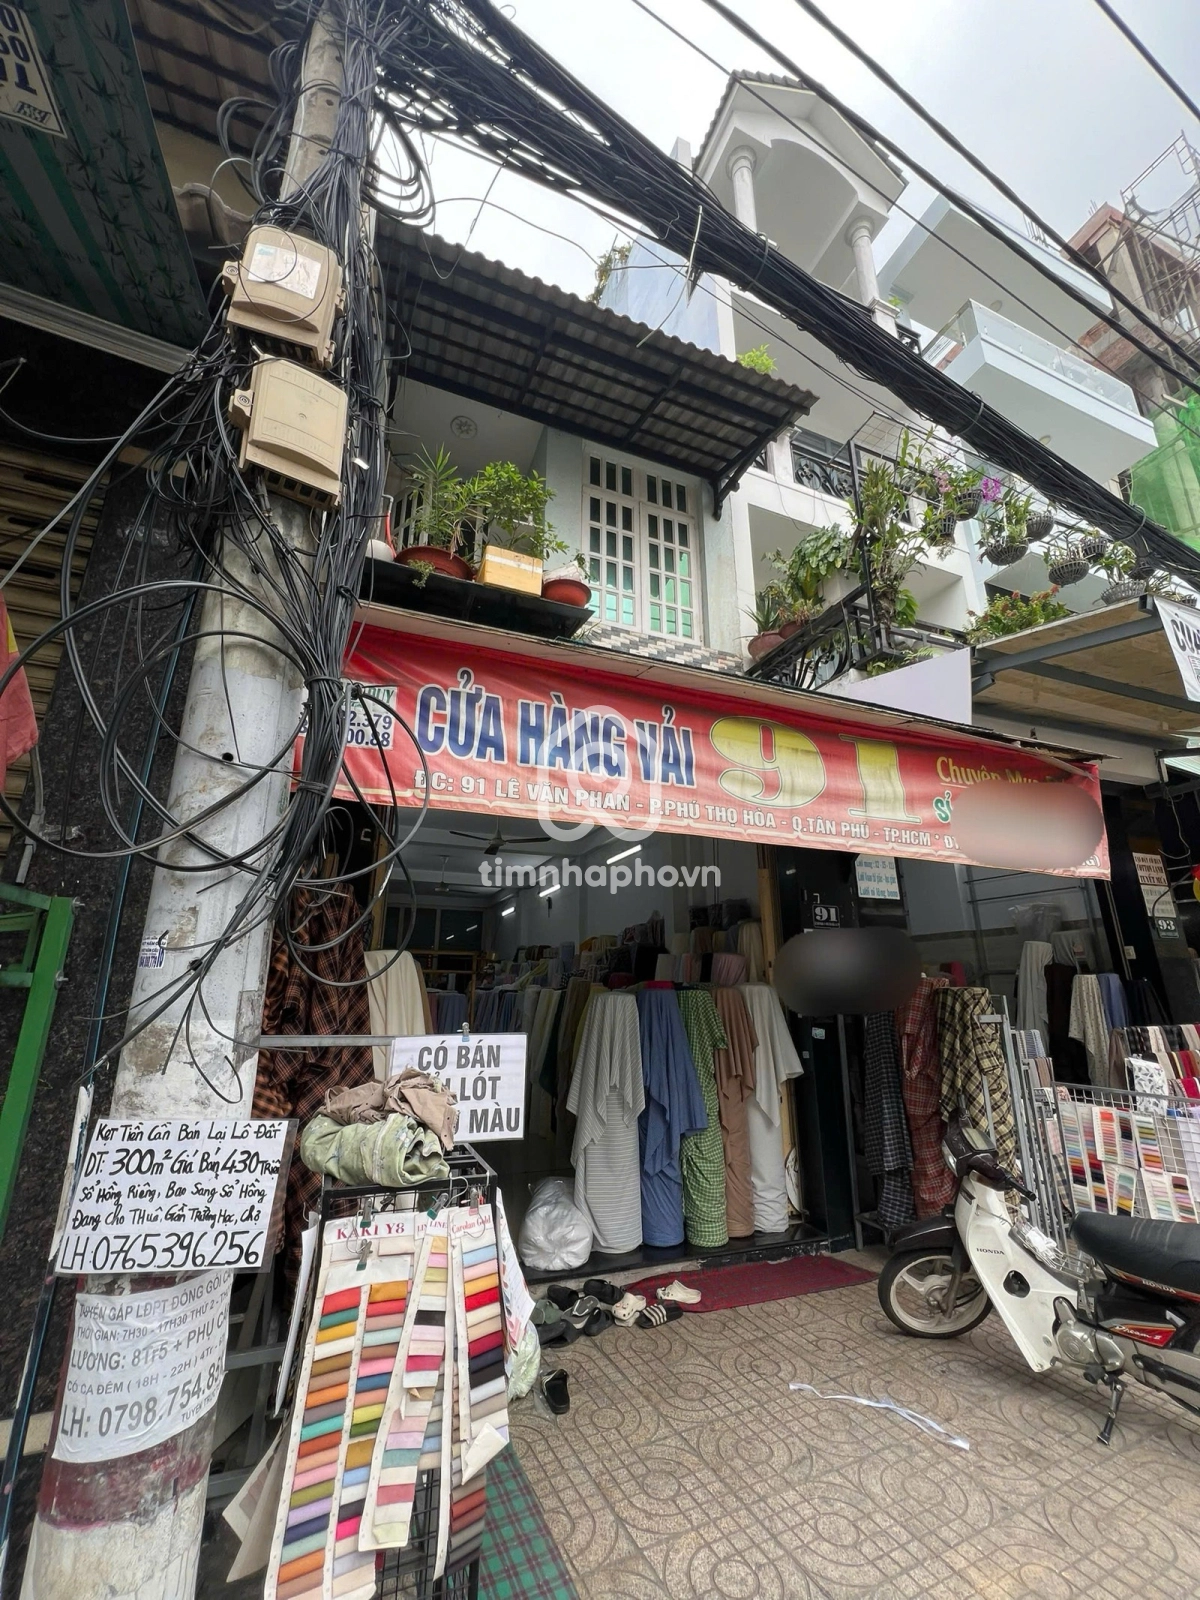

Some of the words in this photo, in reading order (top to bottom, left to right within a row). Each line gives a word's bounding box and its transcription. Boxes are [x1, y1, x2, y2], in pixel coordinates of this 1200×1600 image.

[415, 667, 507, 764] CỬA
[517, 692, 629, 779] HÀNG
[633, 705, 697, 788] VẢI
[709, 715, 922, 825] 91
[414, 769, 455, 792] ĐC:
[461, 776, 486, 795] 91
[495, 778, 520, 799] LÊ
[527, 780, 569, 806] VĂN
[575, 789, 631, 813] PHAN
[649, 798, 701, 820] P.PHÚ
[705, 804, 737, 827] THỌ
[742, 802, 777, 829] HÒA
[792, 815, 837, 837] Q.TÂN
[840, 819, 871, 840] PHÚ
[884, 827, 932, 847] TP.HCM
[815, 906, 837, 922] 91
[1158, 920, 1176, 931] 93
[417, 1040, 449, 1071] CÓ
[456, 1039, 501, 1069] BÁN
[459, 1070, 502, 1101] LÓT
[468, 1102, 520, 1134] MÀU
[386, 1222, 405, 1235] Y8
[976, 1247, 1005, 1255] HONDA
[61, 1405, 91, 1438] LH:
